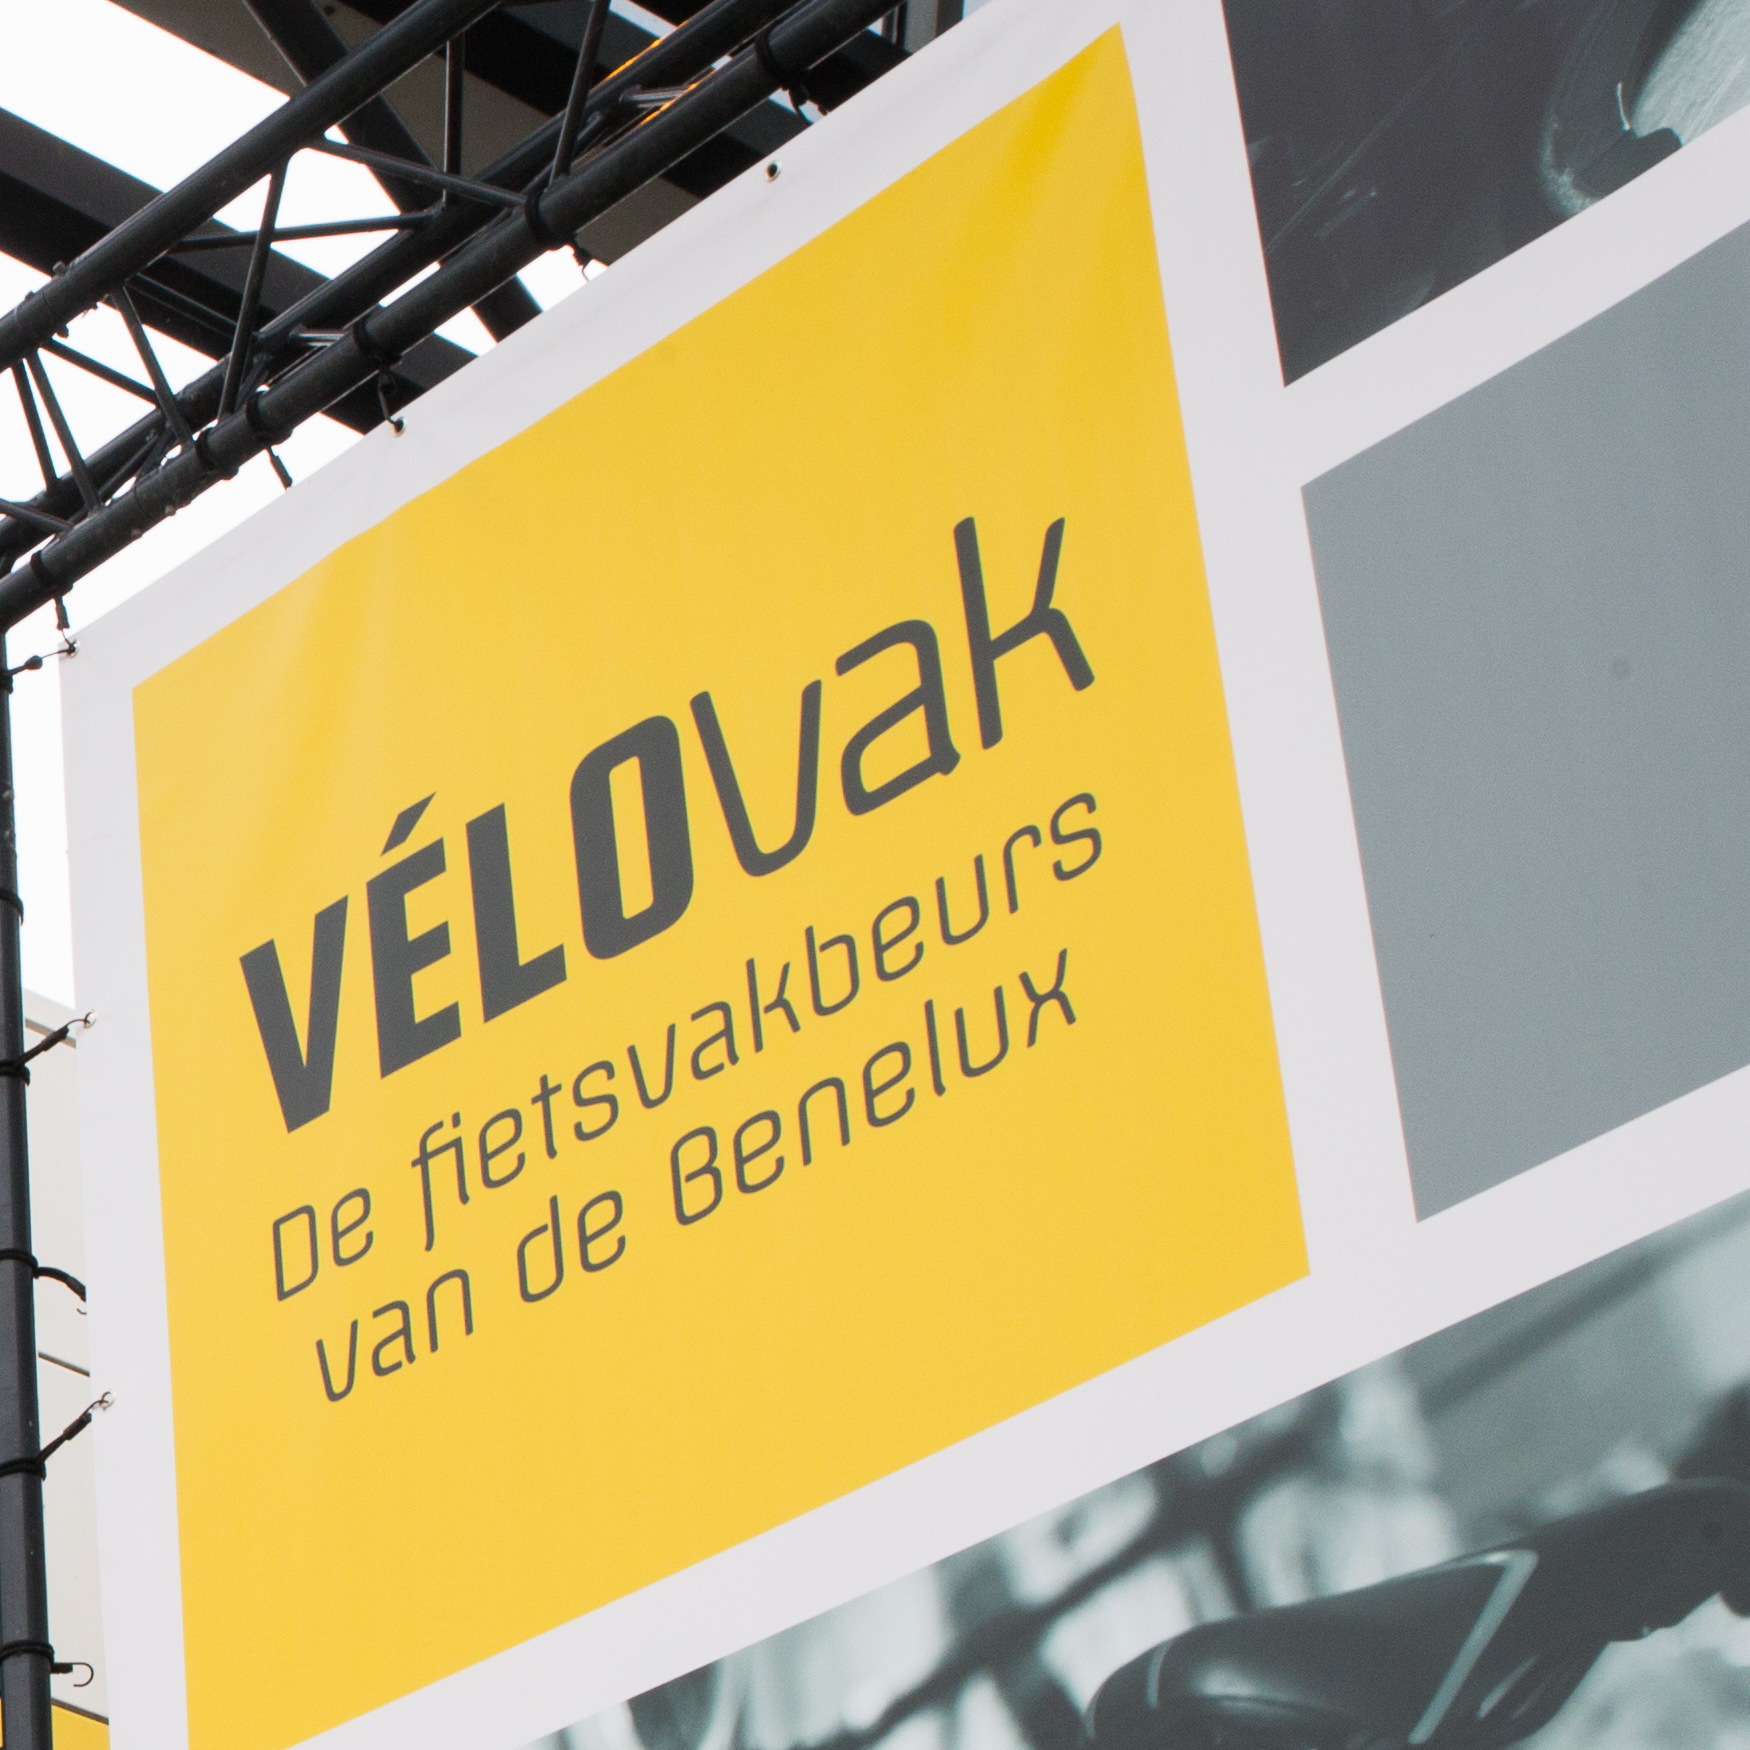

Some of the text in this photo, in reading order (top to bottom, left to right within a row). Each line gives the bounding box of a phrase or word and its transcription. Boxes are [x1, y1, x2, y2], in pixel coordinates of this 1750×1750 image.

[271, 791, 1104, 1303] De fietsvakbeurs
[315, 947, 1078, 1403] van de Benelux
